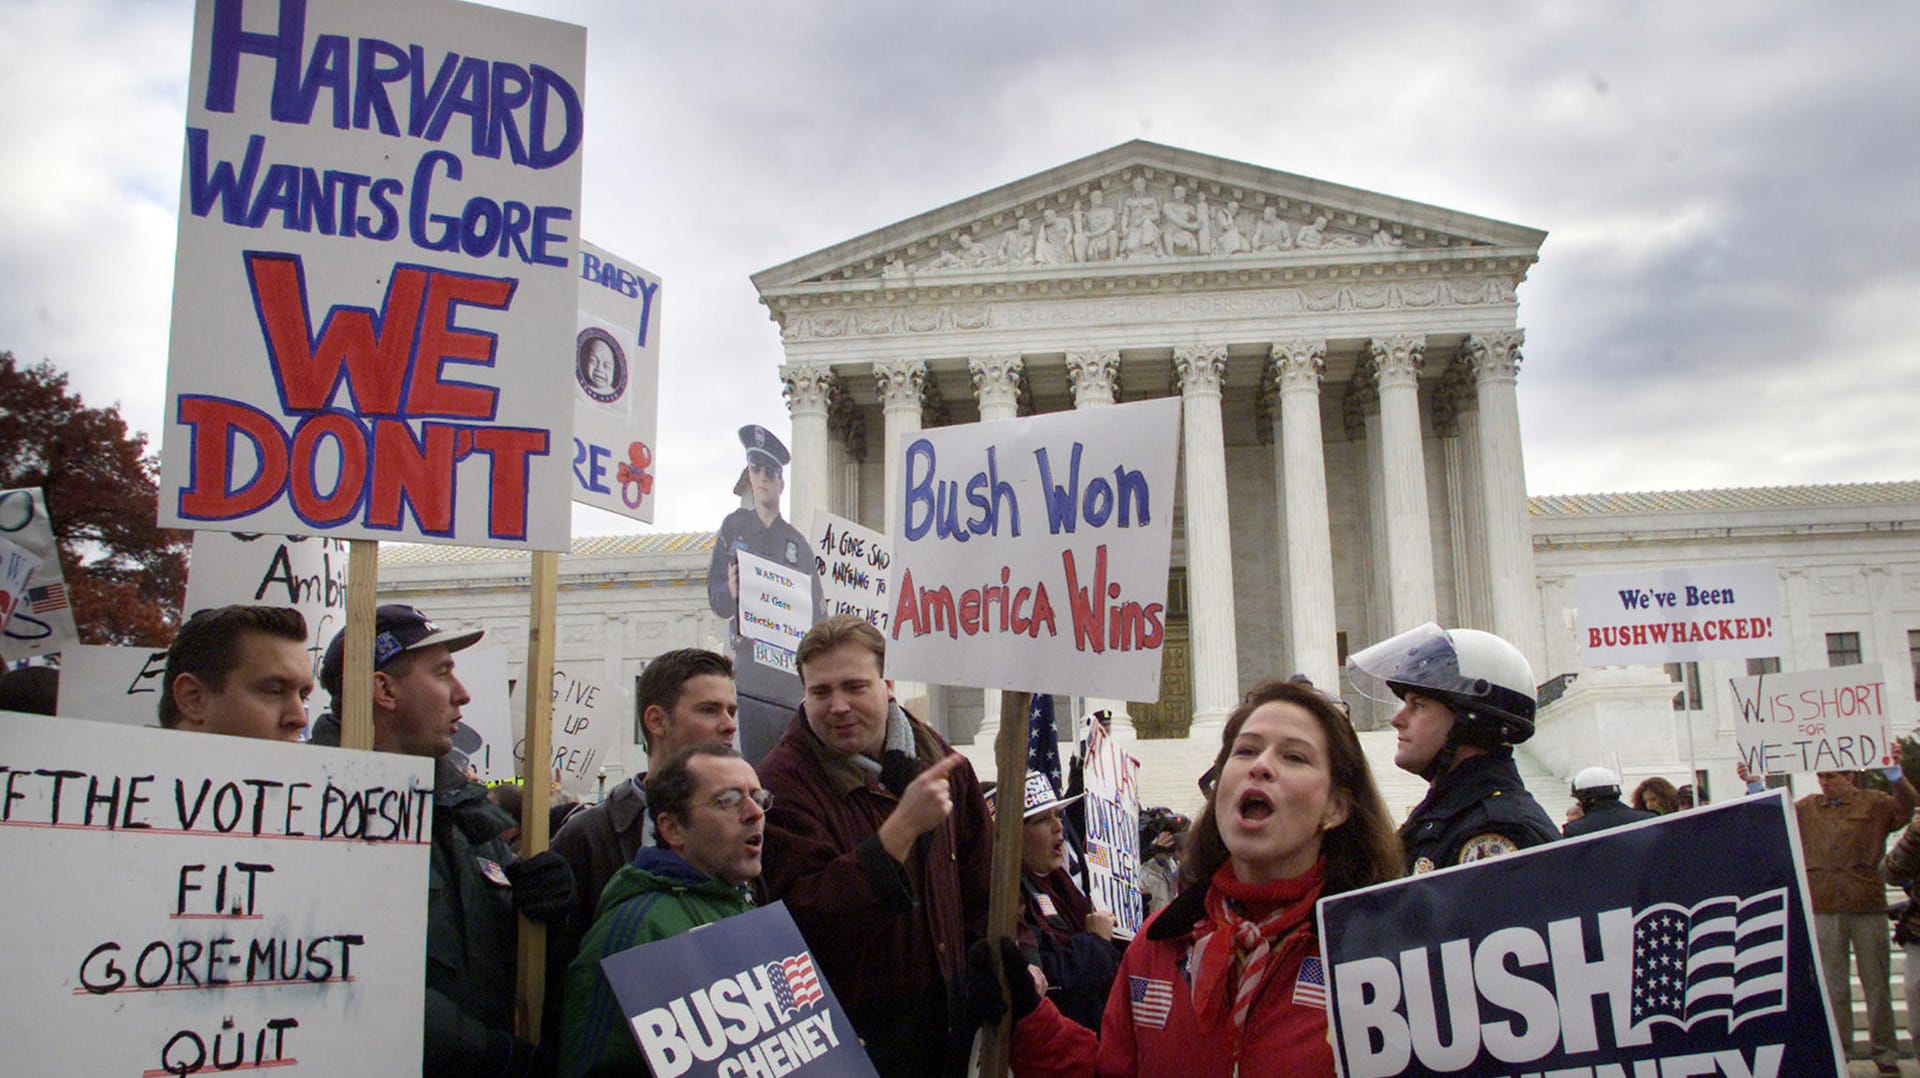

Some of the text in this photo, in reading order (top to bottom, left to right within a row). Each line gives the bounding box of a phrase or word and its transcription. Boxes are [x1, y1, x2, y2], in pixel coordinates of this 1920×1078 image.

[205, 0, 583, 170] HARVARD
[187, 127, 572, 268] WANTS GORE
[579, 252, 658, 348] BABY
[243, 250, 518, 422] WE
[177, 394, 550, 542] DON'T
[573, 437, 611, 496] RE
[905, 438, 1150, 542] Bush Won
[839, 531, 864, 557] GORE
[1062, 544, 1164, 655] Wins
[1588, 616, 1773, 648] BUSHWHACKED!
[1618, 585, 1735, 610] We've Been
[564, 714, 589, 736] UP
[1729, 674, 1885, 723] W. IS SHORT
[1799, 722, 1826, 737] FOR
[34, 768, 154, 830] THE
[175, 777, 312, 837] VOTE
[177, 862, 274, 916] FIT
[632, 964, 791, 1078] BUSH
[1333, 907, 1652, 1078] BUSH
[162, 1020, 299, 1078] QUIT
[717, 1008, 840, 1078] CHENEY
